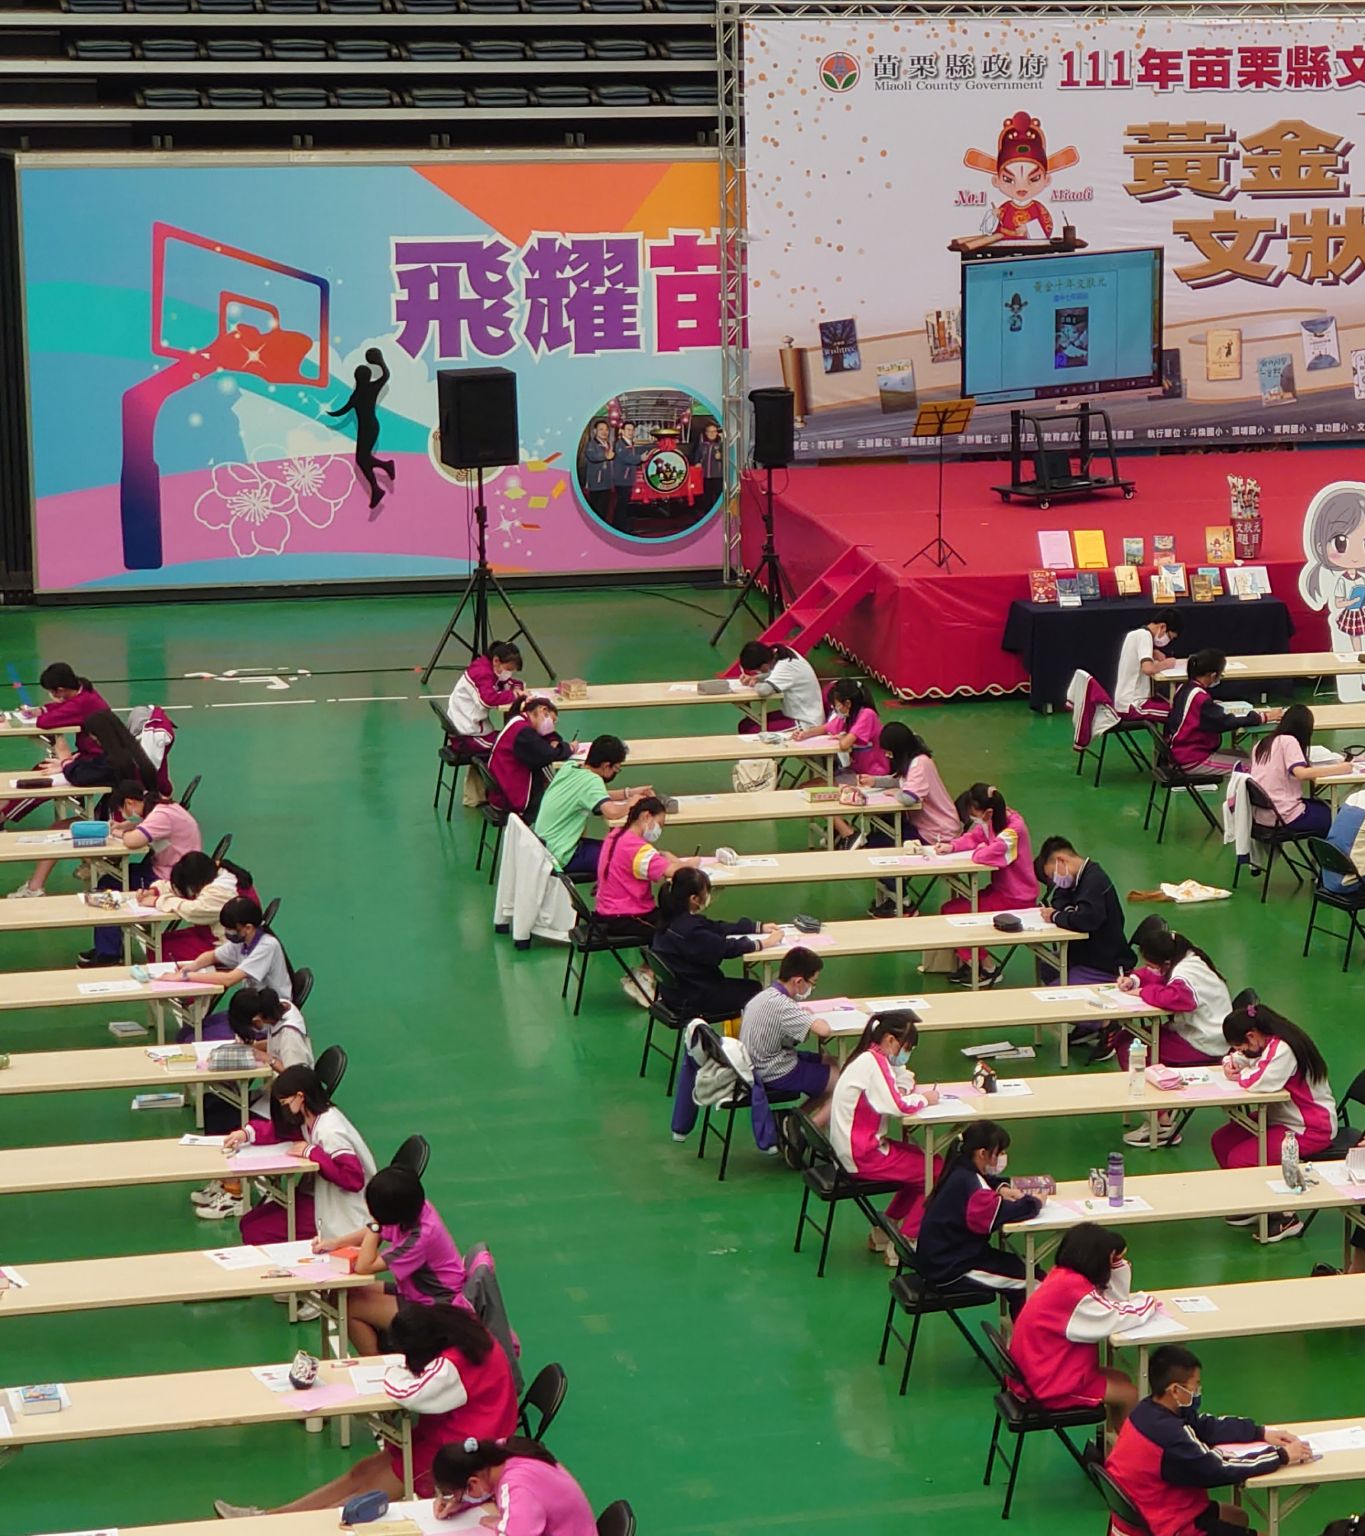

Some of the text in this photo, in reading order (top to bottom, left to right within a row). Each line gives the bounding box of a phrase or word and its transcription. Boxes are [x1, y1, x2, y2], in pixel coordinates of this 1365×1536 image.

[872, 53, 1047, 79] 苗栗縣政府
[874, 80, 1044, 92] Miaoli County Government
[393, 232, 749, 361] 飛耀苗
